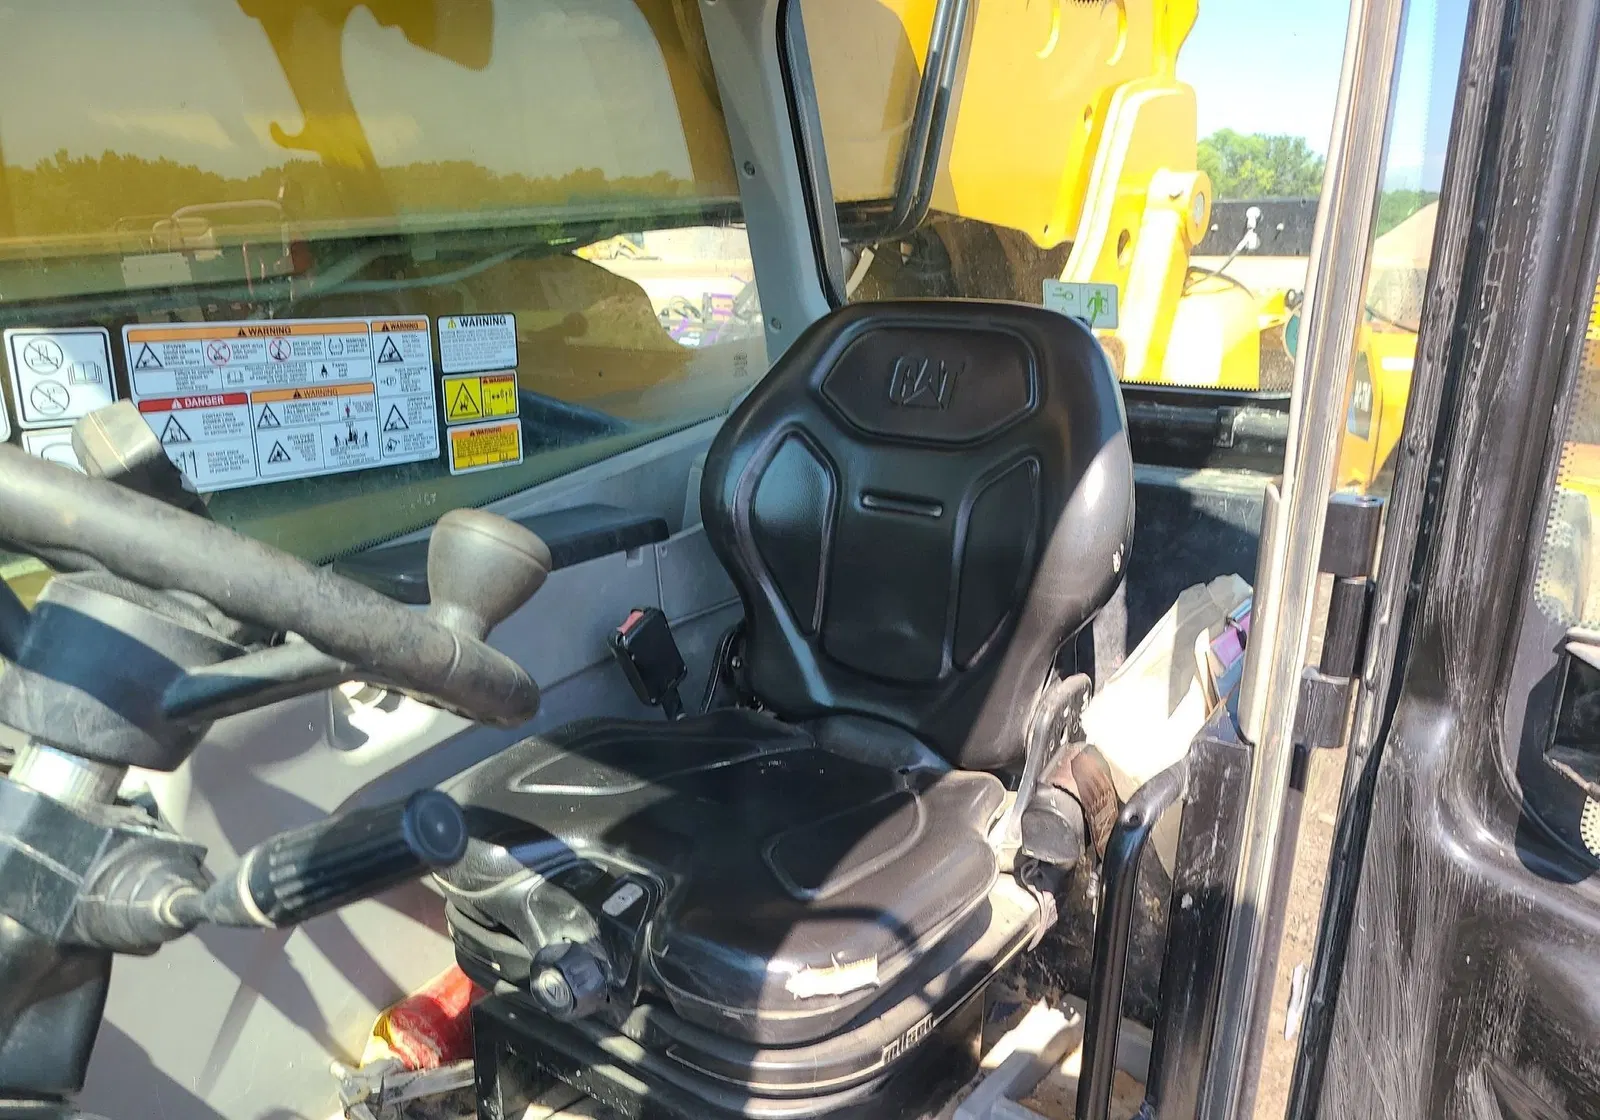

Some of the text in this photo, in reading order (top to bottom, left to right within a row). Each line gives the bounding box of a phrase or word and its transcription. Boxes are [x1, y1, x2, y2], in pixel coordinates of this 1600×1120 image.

[390, 321, 419, 331] WARNING
[459, 315, 506, 328] WARNING
[248, 325, 292, 337] WARNING
[304, 387, 338, 399] WARNING
[184, 395, 225, 408] DANGER
[476, 426, 502, 437] WARNING
